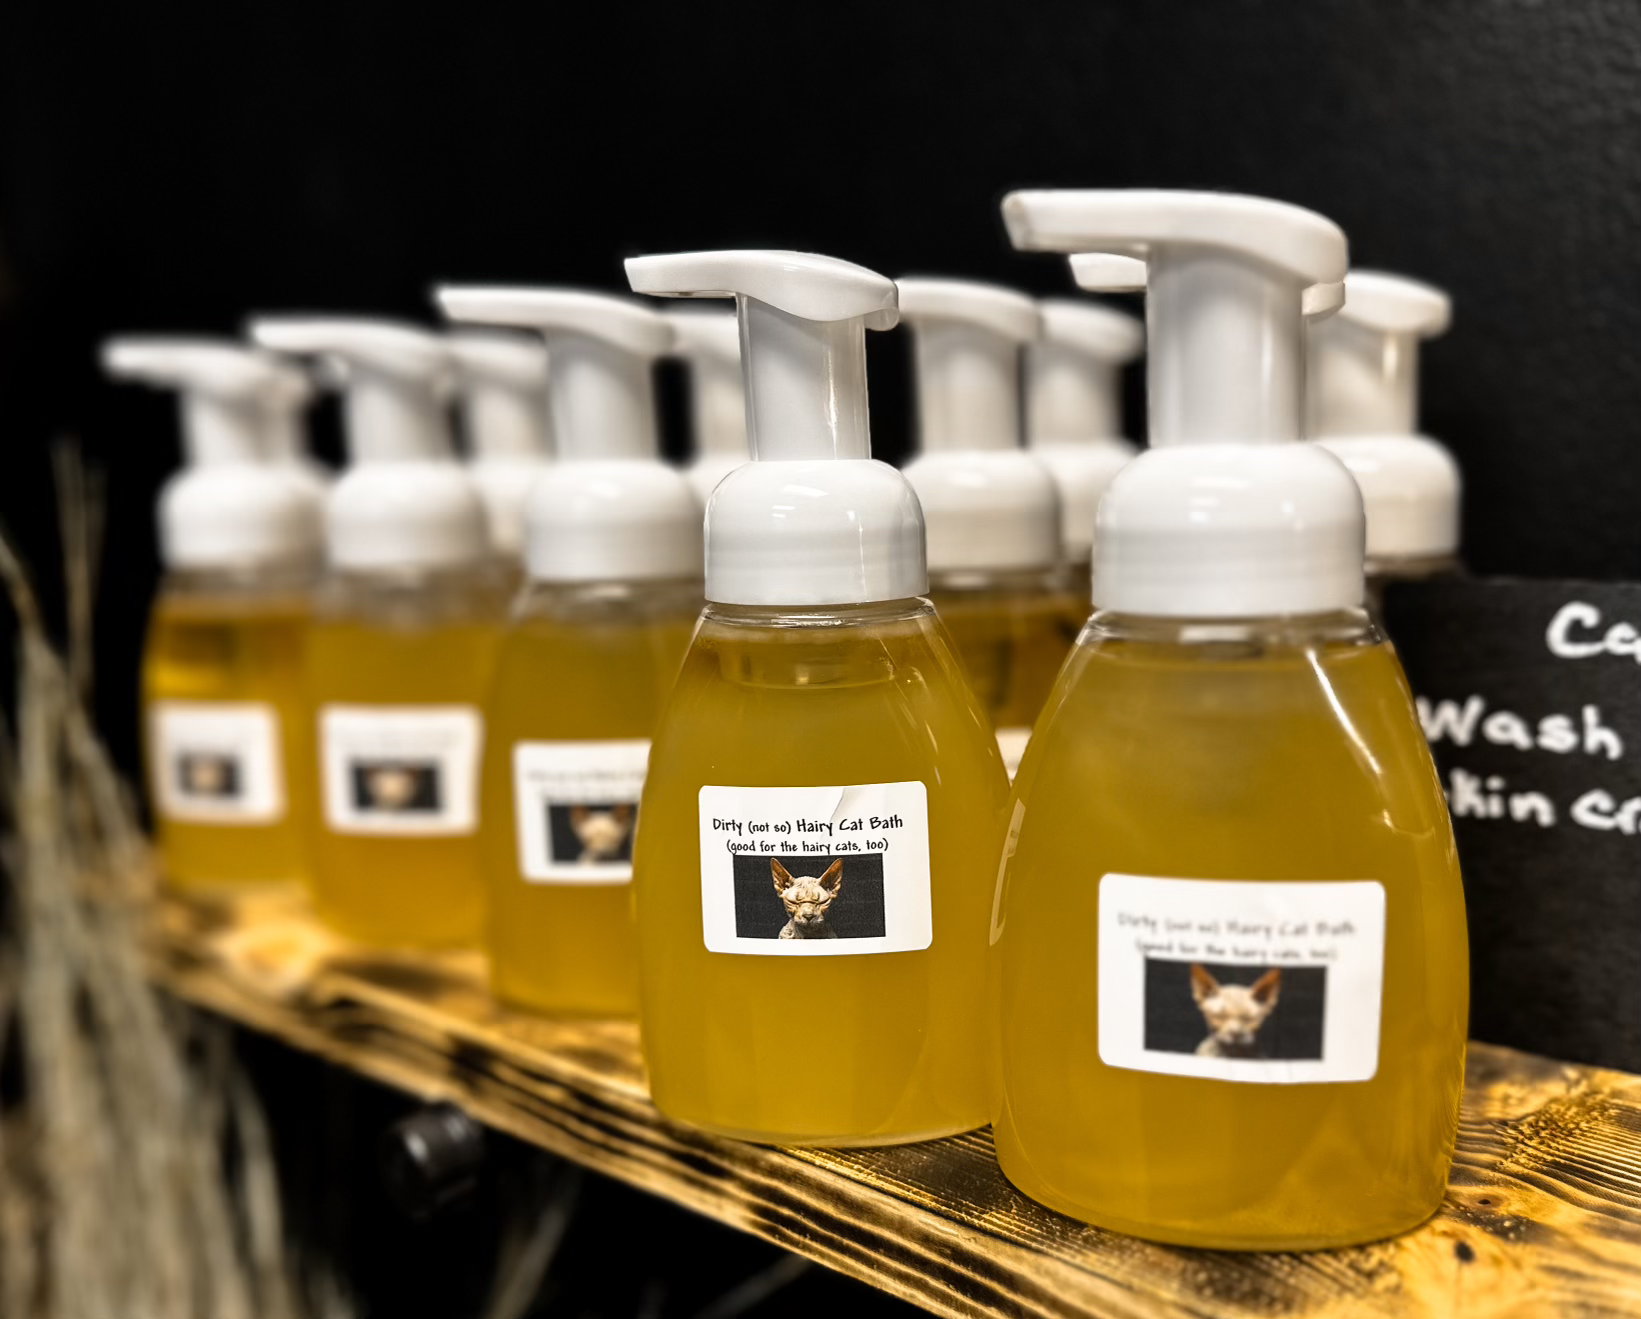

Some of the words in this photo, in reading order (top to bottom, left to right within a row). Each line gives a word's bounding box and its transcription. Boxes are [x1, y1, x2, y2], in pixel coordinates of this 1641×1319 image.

[1415, 694, 1623, 761] Wash
[1446, 767, 1556, 828] kin
[712, 818, 743, 836] Dirty
[748, 821, 770, 835] (not
[774, 821, 792, 835] so)
[796, 818, 833, 837] Hairy
[839, 817, 864, 832] Cat
[870, 814, 904, 830] Bath
[726, 839, 756, 856] (good
[759, 840, 776, 853] for
[780, 840, 798, 853] the
[802, 840, 831, 855] hairy
[835, 841, 862, 853] cats,
[866, 837, 889, 852] too)
